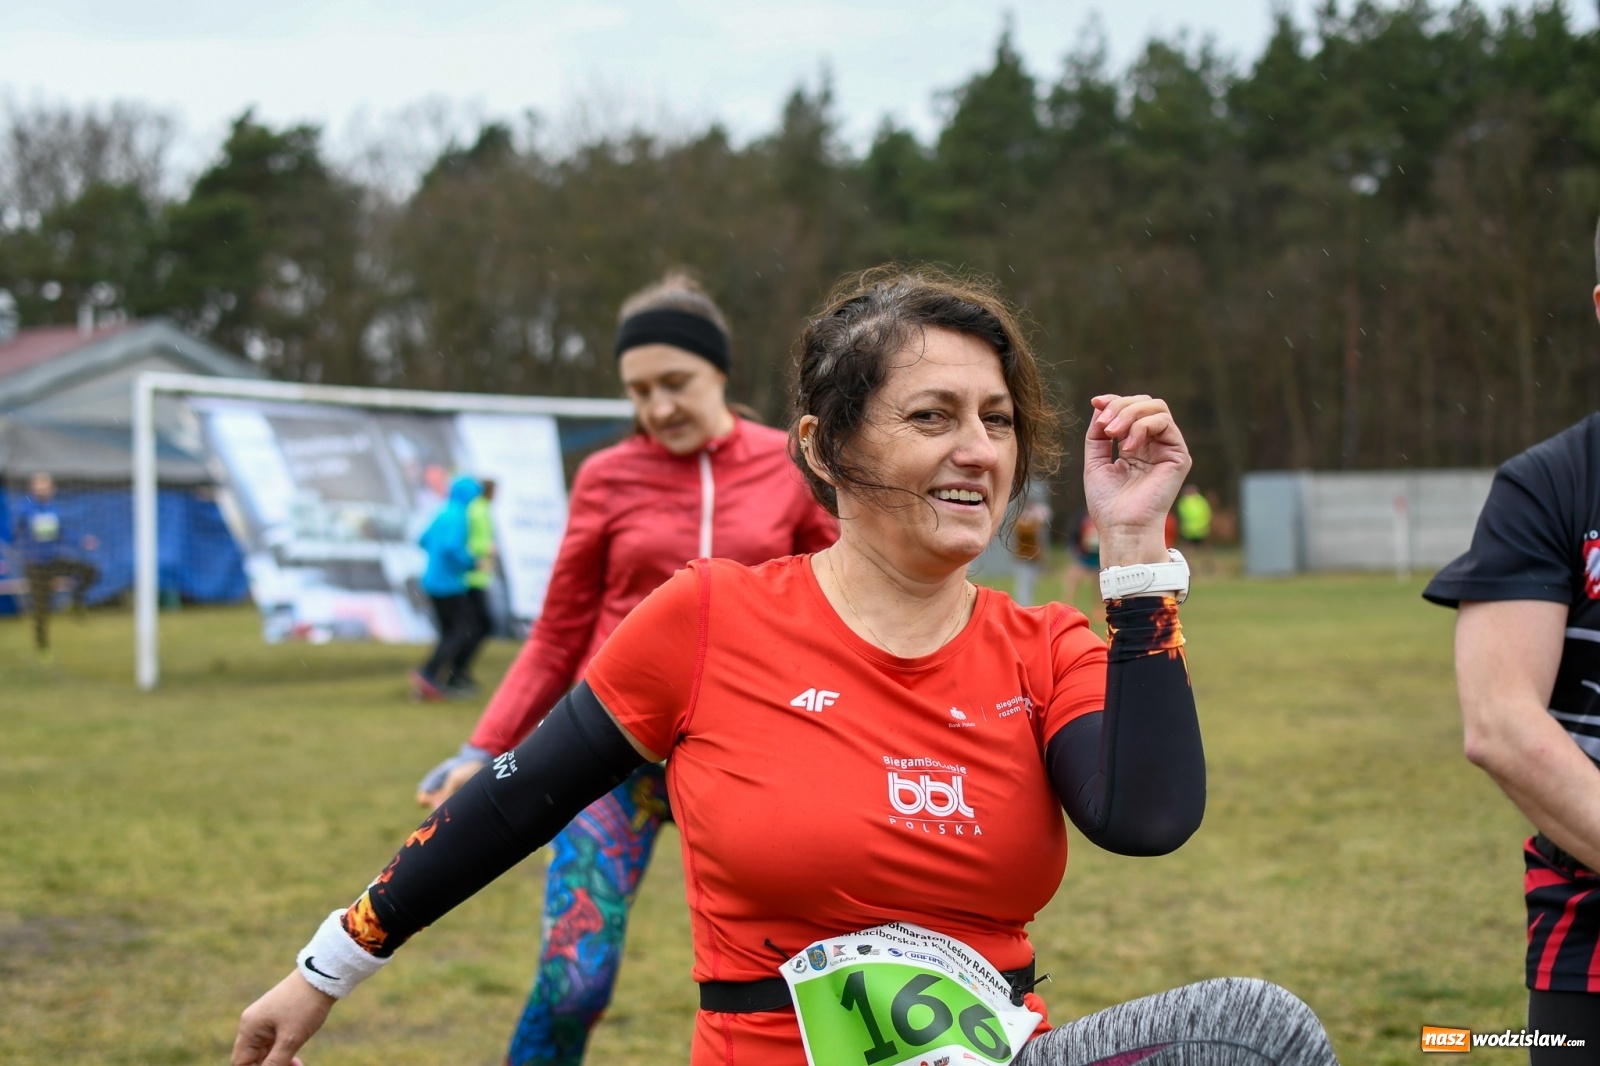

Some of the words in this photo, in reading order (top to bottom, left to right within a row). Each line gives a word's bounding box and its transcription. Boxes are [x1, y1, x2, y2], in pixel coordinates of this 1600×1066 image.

[790, 688, 840, 712] 4F
[998, 705, 1021, 718] razem
[887, 771, 974, 818] bbl
[889, 817, 983, 836] POLSKA
[946, 940, 972, 966] Leśny
[968, 971, 991, 993] 2023
[840, 970, 1012, 1066] 166
